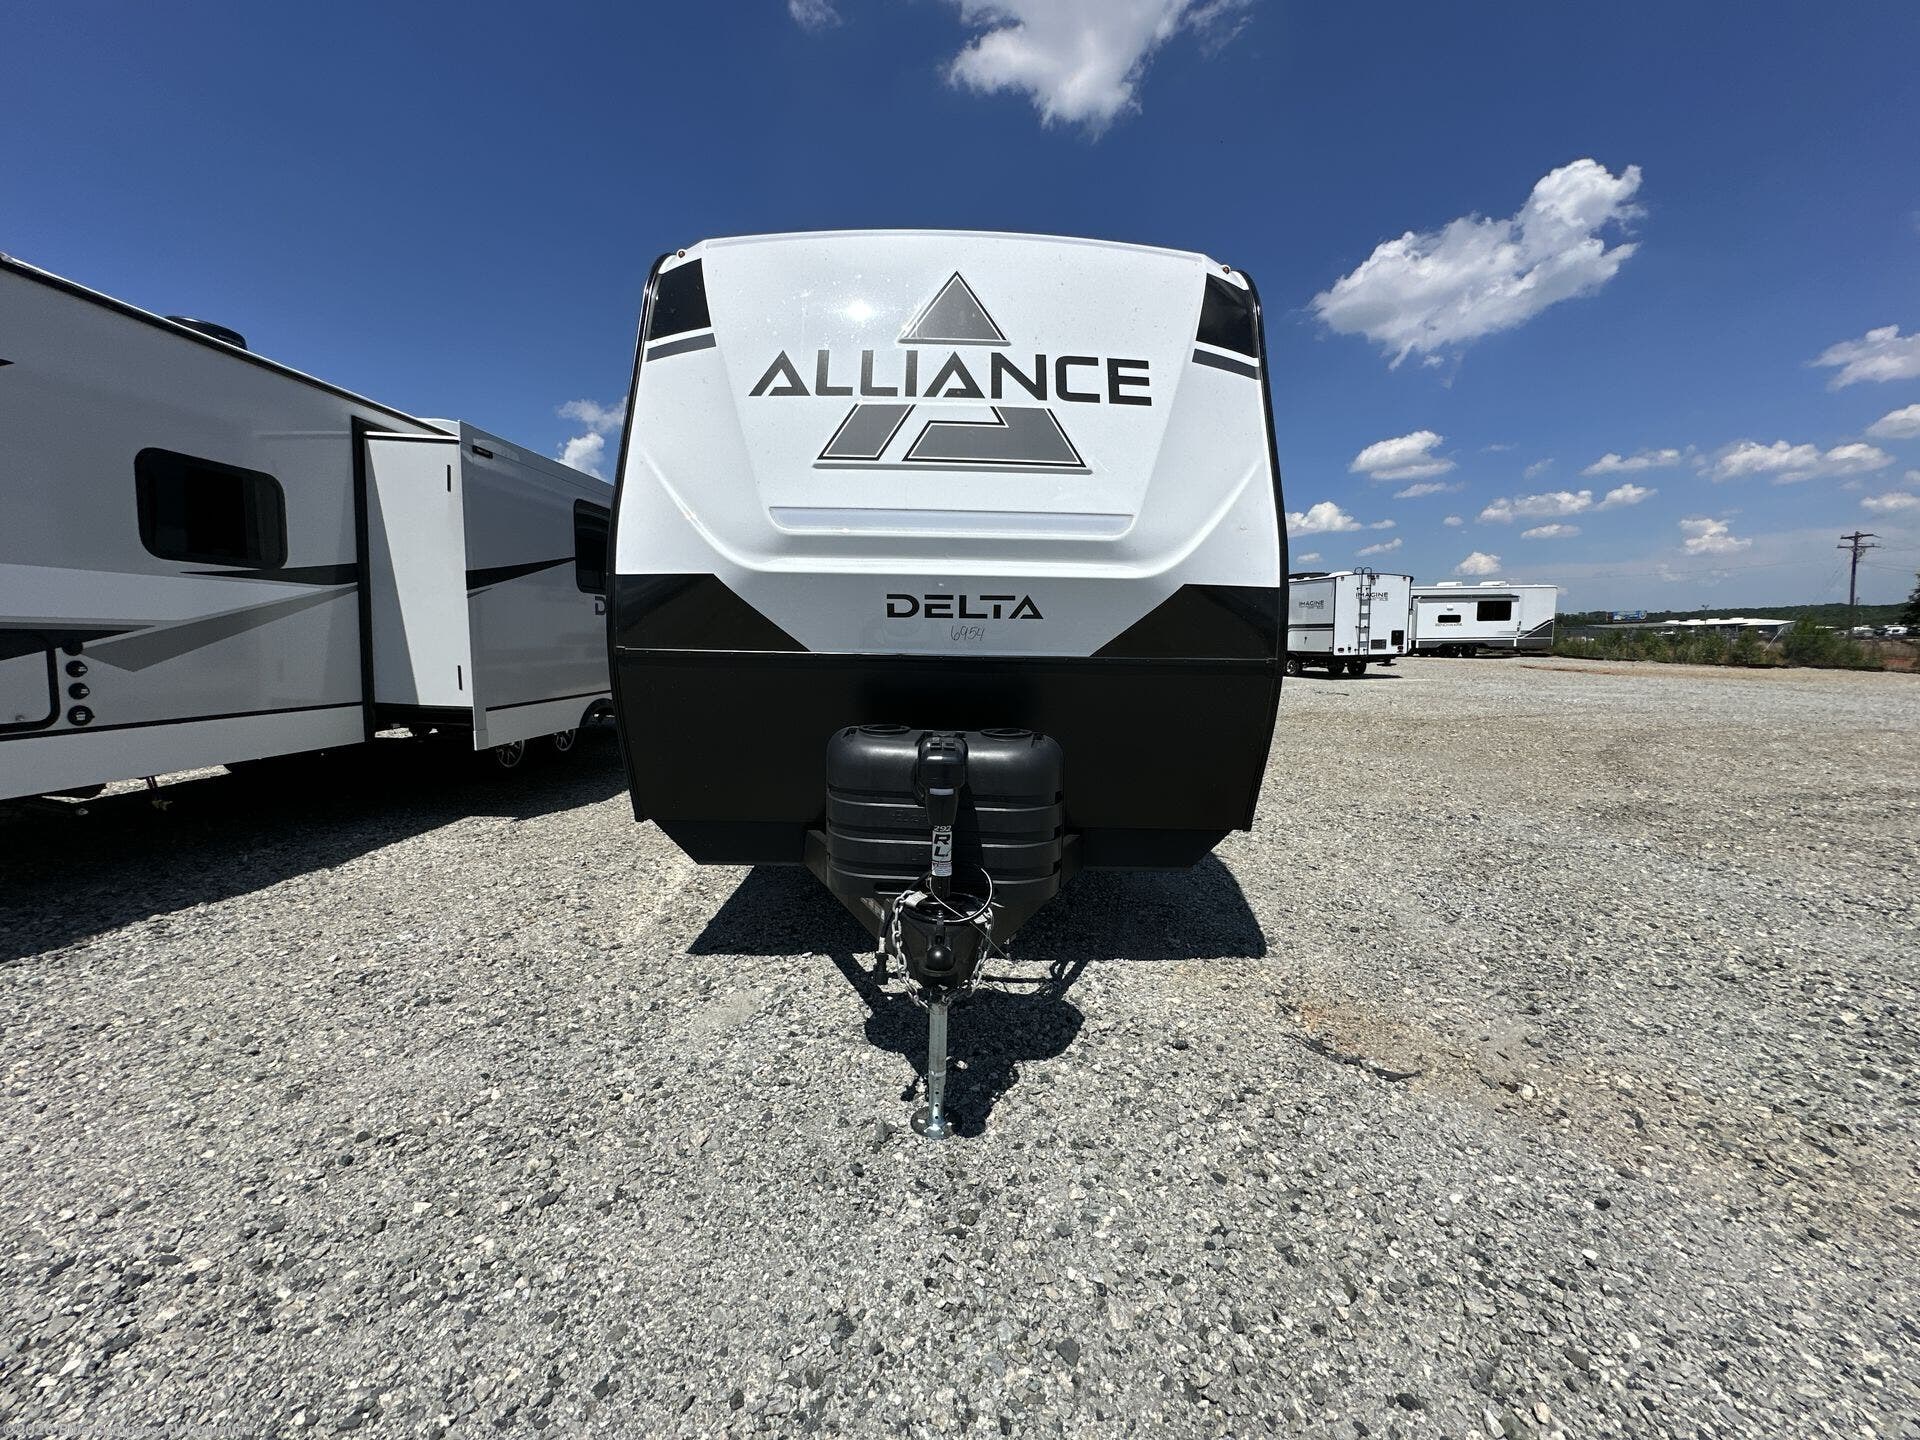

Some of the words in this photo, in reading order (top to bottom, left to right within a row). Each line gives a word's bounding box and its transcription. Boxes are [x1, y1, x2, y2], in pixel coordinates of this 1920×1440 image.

[748, 350, 1152, 406] ALLIANCE
[886, 593, 1044, 620] DELTA
[950, 625, 985, 641] 6954
